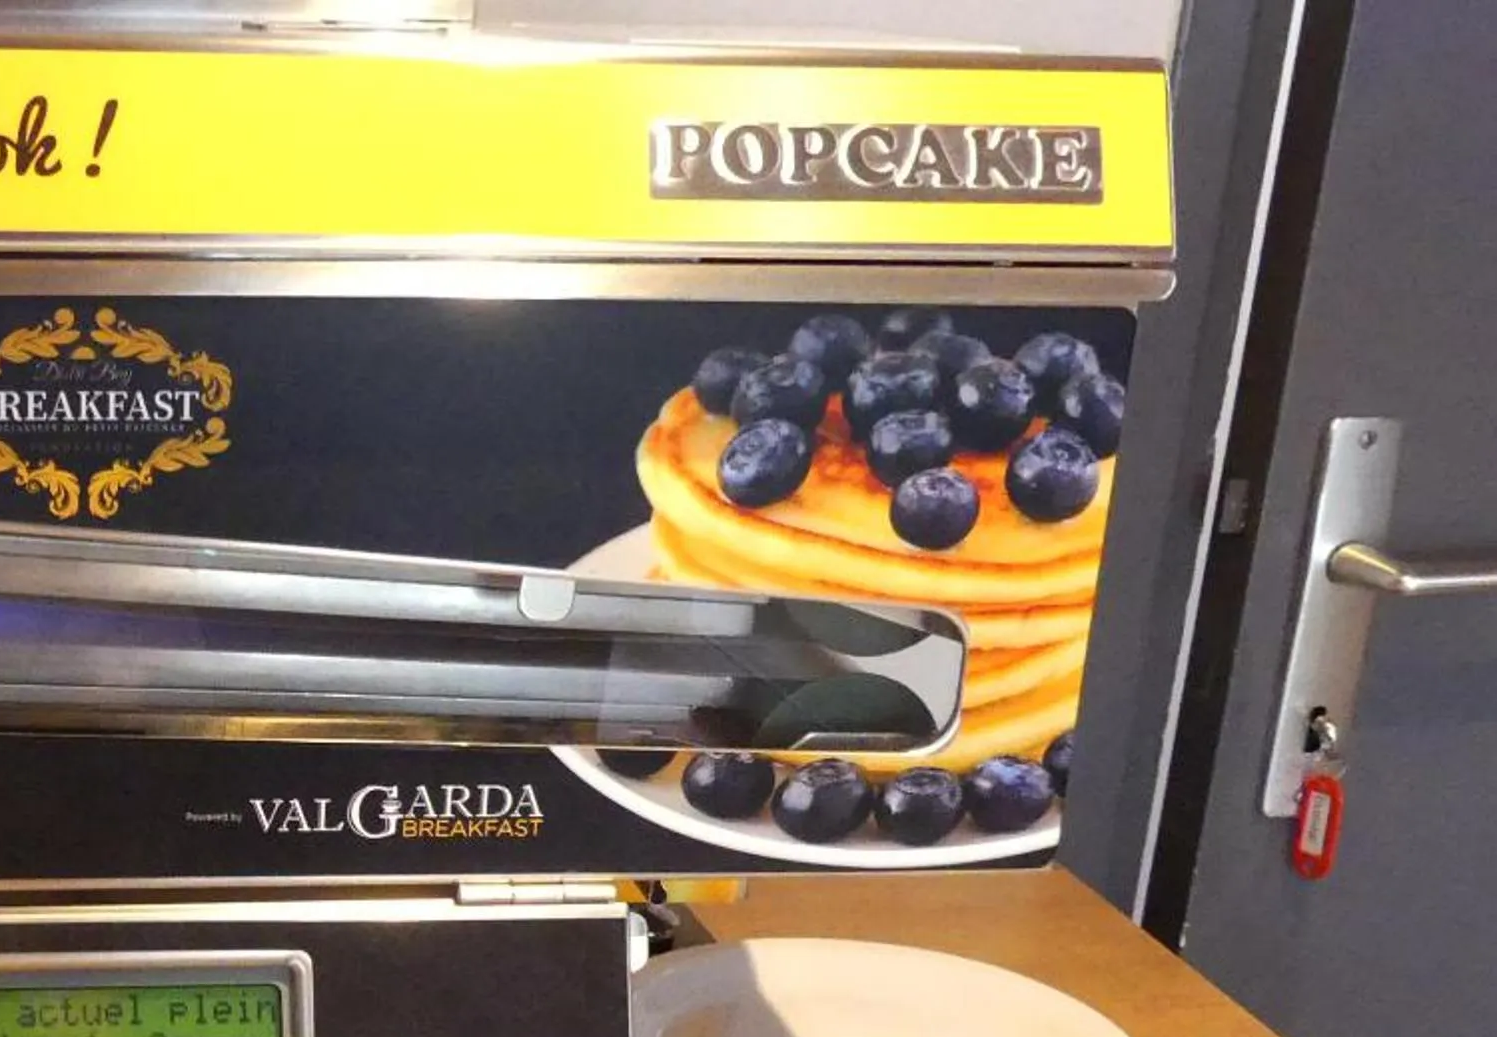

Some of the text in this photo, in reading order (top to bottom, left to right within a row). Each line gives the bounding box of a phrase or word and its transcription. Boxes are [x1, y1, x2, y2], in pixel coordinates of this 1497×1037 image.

[83, 100, 119, 178] !
[653, 121, 1091, 192] POPCAKE
[403, 818, 544, 838] BREAKFAST
[17, 991, 143, 1028] actuel
[168, 986, 276, 1027] plein
